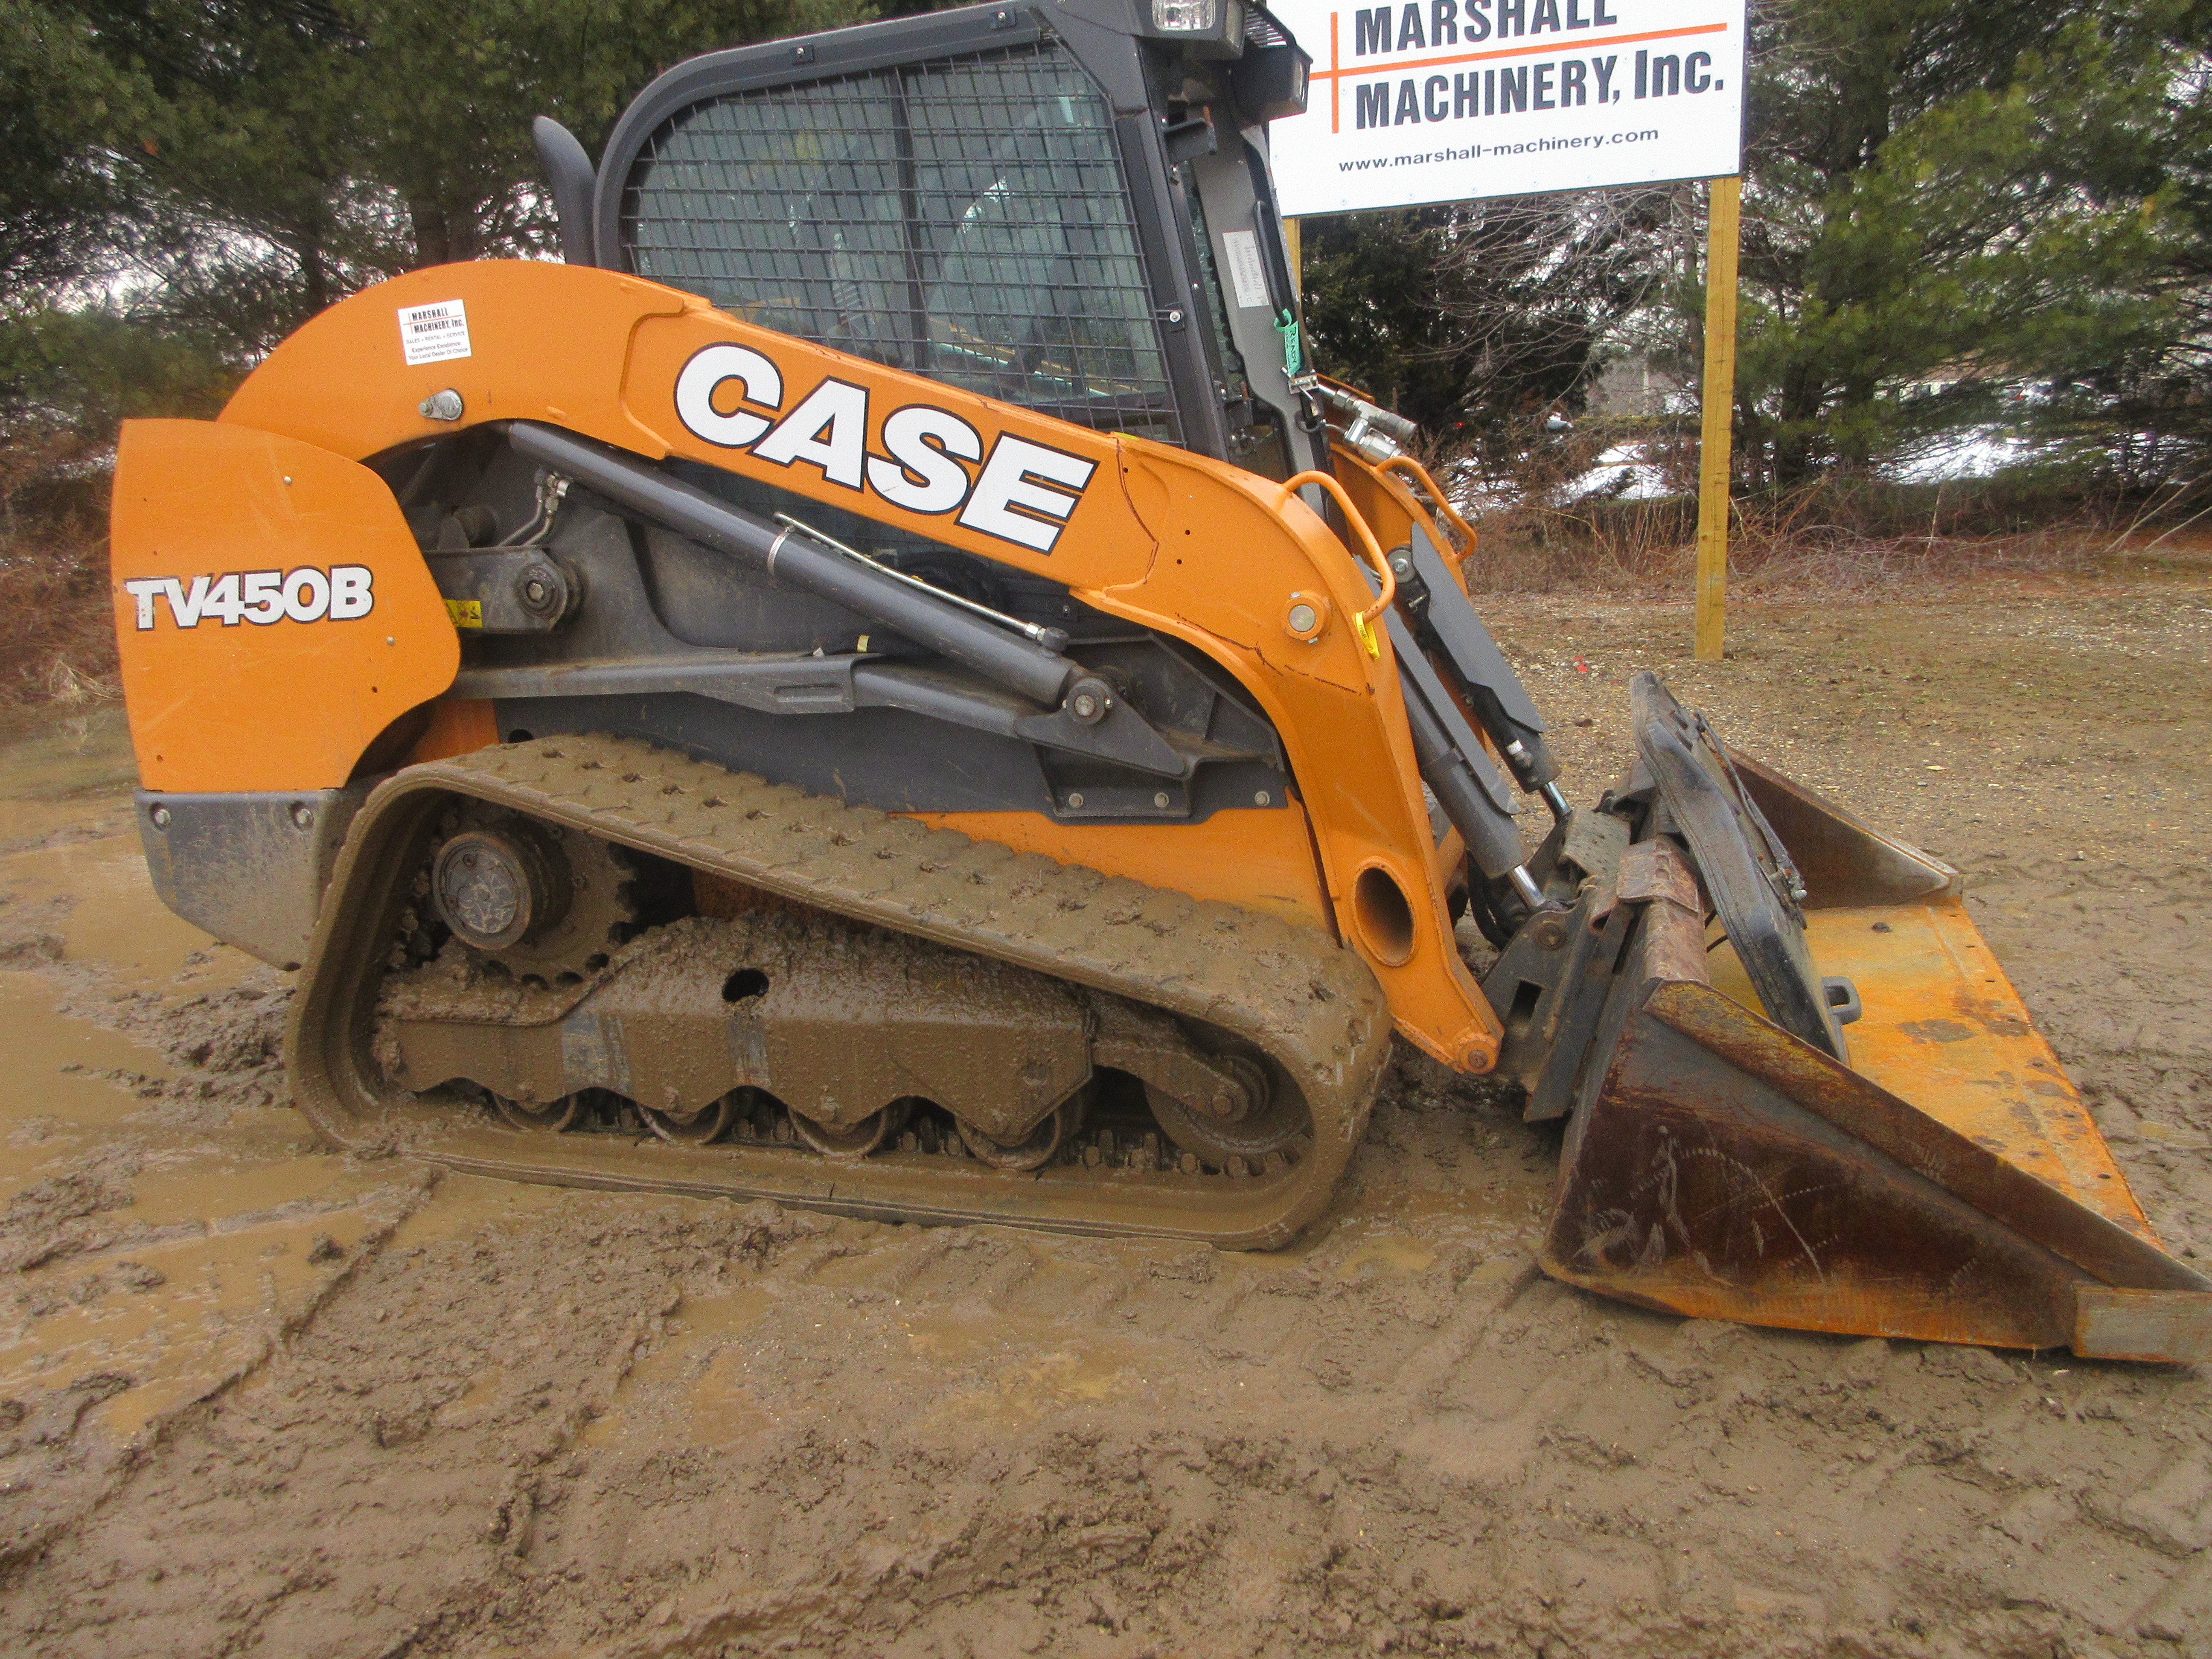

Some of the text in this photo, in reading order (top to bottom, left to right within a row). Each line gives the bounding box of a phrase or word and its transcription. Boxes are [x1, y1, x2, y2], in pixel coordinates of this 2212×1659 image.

[1356, 0, 1617, 56] MARSHALL
[1356, 49, 1723, 130] MACHINERY, Inc.
[1339, 129, 1658, 172] www.marshall-machinery.com
[412, 308, 448, 321] MARSHALL
[451, 319, 464, 328] Inc.
[674, 341, 1100, 556] CASE
[124, 563, 375, 631] TV450B
